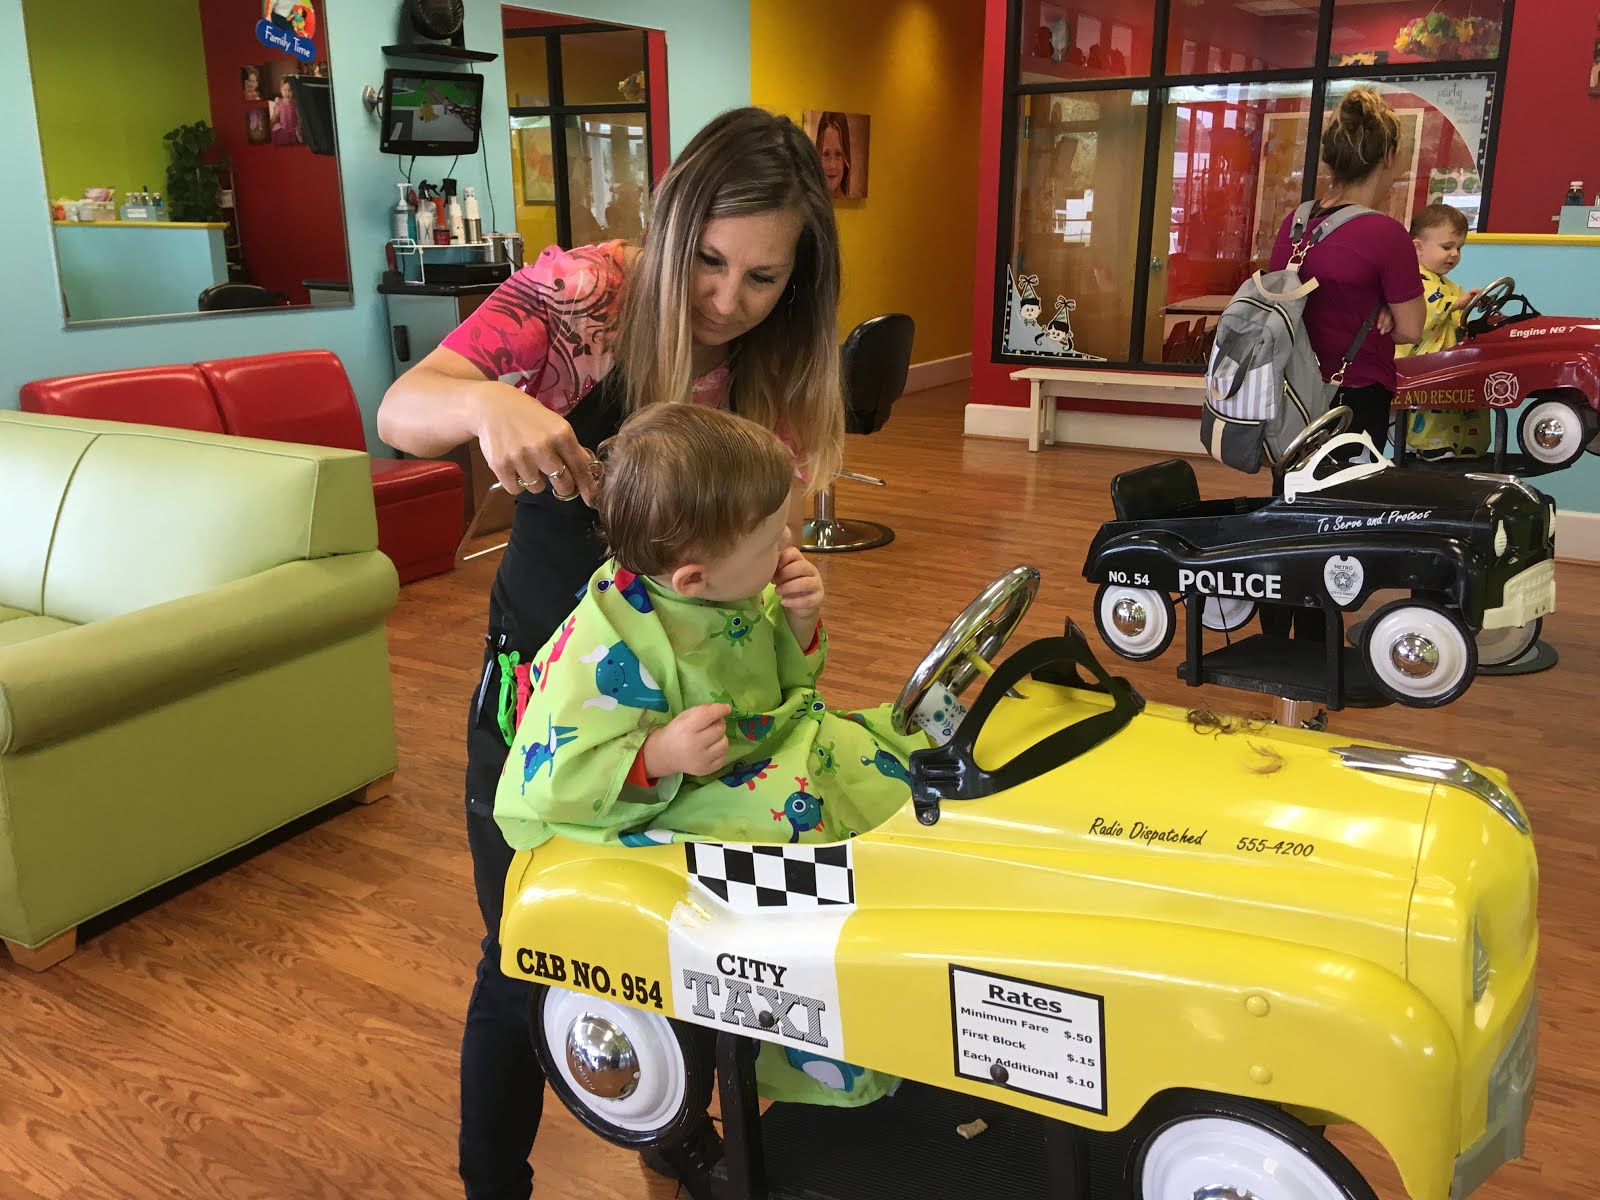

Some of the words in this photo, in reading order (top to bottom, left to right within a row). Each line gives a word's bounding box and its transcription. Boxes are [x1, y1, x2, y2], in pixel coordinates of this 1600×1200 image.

[265, 25, 291, 52] Family
[293, 36, 311, 58] Time
[1509, 327, 1547, 339] Engine
[1404, 390, 1428, 405] AND
[1430, 389, 1475, 405] RESCUE
[1317, 517, 1329, 533] To
[1333, 515, 1363, 531] Serve
[1366, 511, 1386, 527] and
[1387, 510, 1432, 525] Protect
[1108, 570, 1130, 585] NO.
[1133, 573, 1150, 586] 54
[1178, 568, 1282, 600] POLICE
[1088, 817, 1124, 838] Radio
[1129, 820, 1208, 847] Dispatched
[1235, 836, 1315, 858] 555-4200
[516, 947, 567, 982] CAB
[572, 959, 616, 996] NO.
[621, 972, 664, 1009] 954
[716, 952, 788, 989] CITY
[682, 969, 829, 1048] TAXI
[988, 983, 1063, 1014] Rates
[960, 1006, 1018, 1026] Minimum
[1021, 1020, 1050, 1034] Fare
[1063, 1030, 1093, 1044] $.50
[962, 1028, 990, 1042] First
[992, 1035, 1027, 1050] Block
[963, 1049, 992, 1063] Each
[995, 1057, 1059, 1080] Additional
[1066, 1075, 1095, 1090] $.10
[1066, 1053, 1096, 1068] $.15
